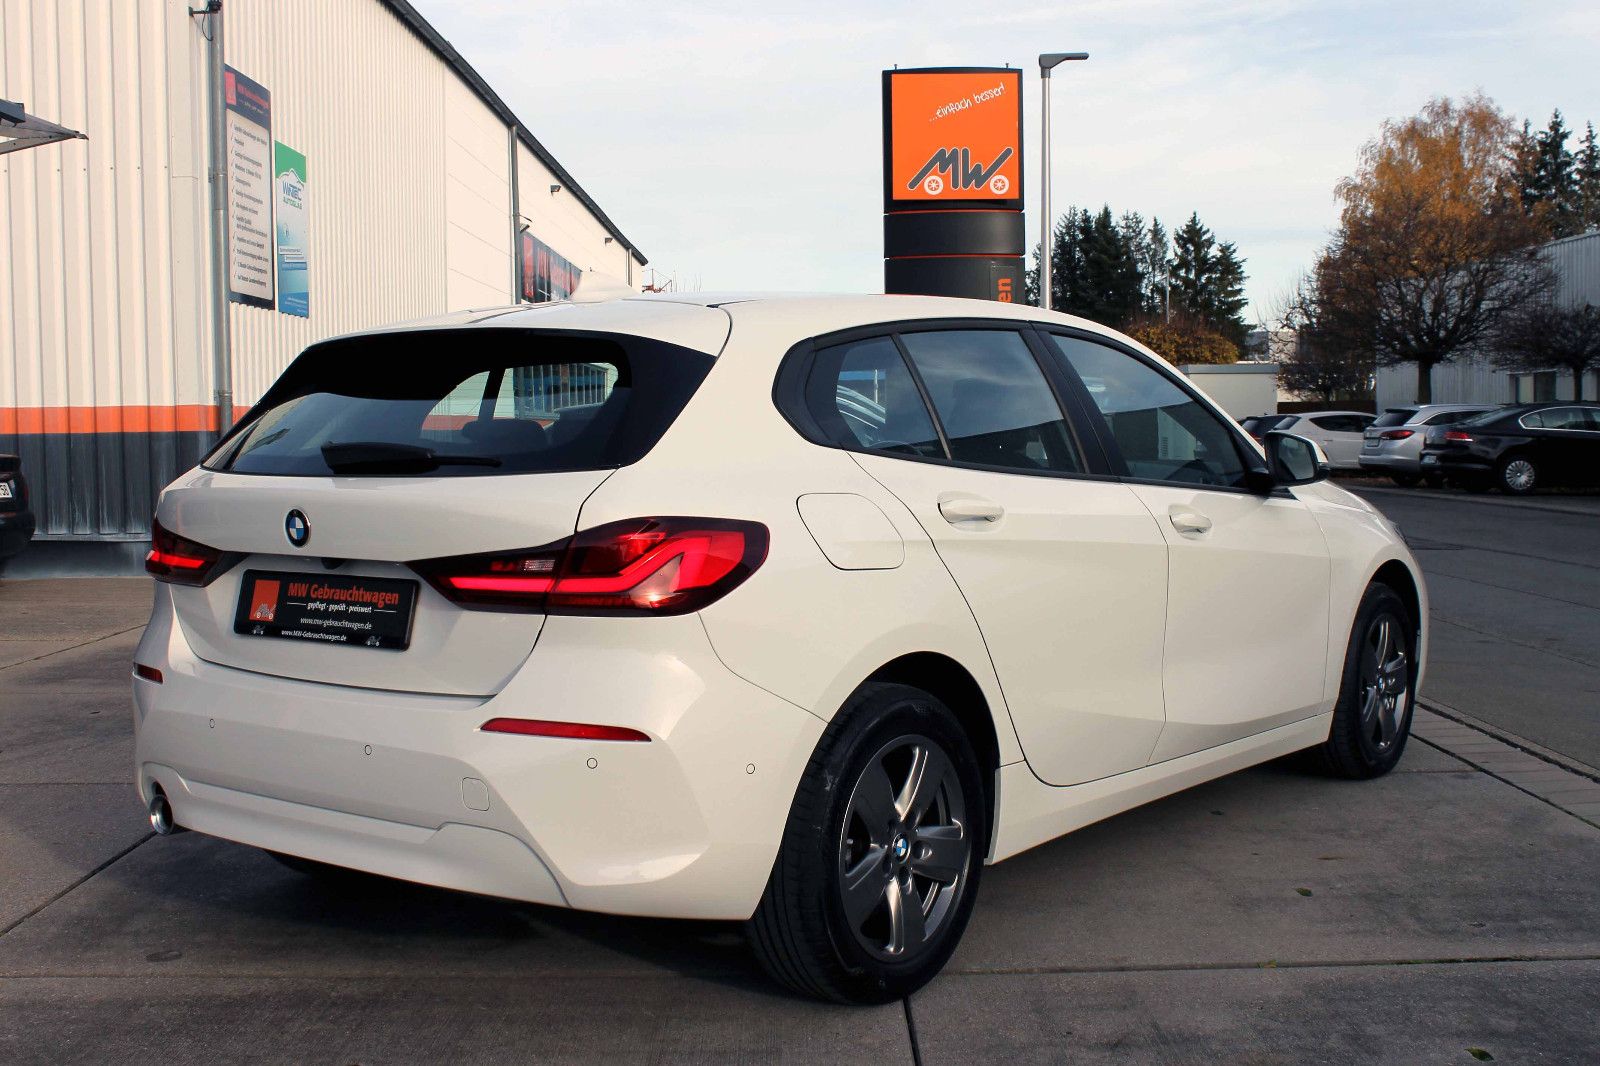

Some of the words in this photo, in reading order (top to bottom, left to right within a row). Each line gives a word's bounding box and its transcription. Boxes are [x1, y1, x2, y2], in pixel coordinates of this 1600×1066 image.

[907, 147, 1013, 191] MW
[288, 583, 309, 598] MW
[310, 584, 399, 609] Gebrauchtwagen
[307, 601, 327, 611] gepflegt
[328, 604, 346, 612] geprüft
[348, 605, 372, 613] preiswert
[300, 618, 372, 630] www.mw-gebrauchtwagen.de
[281, 630, 347, 641] www.MW-Gebrauchtwagen.de
